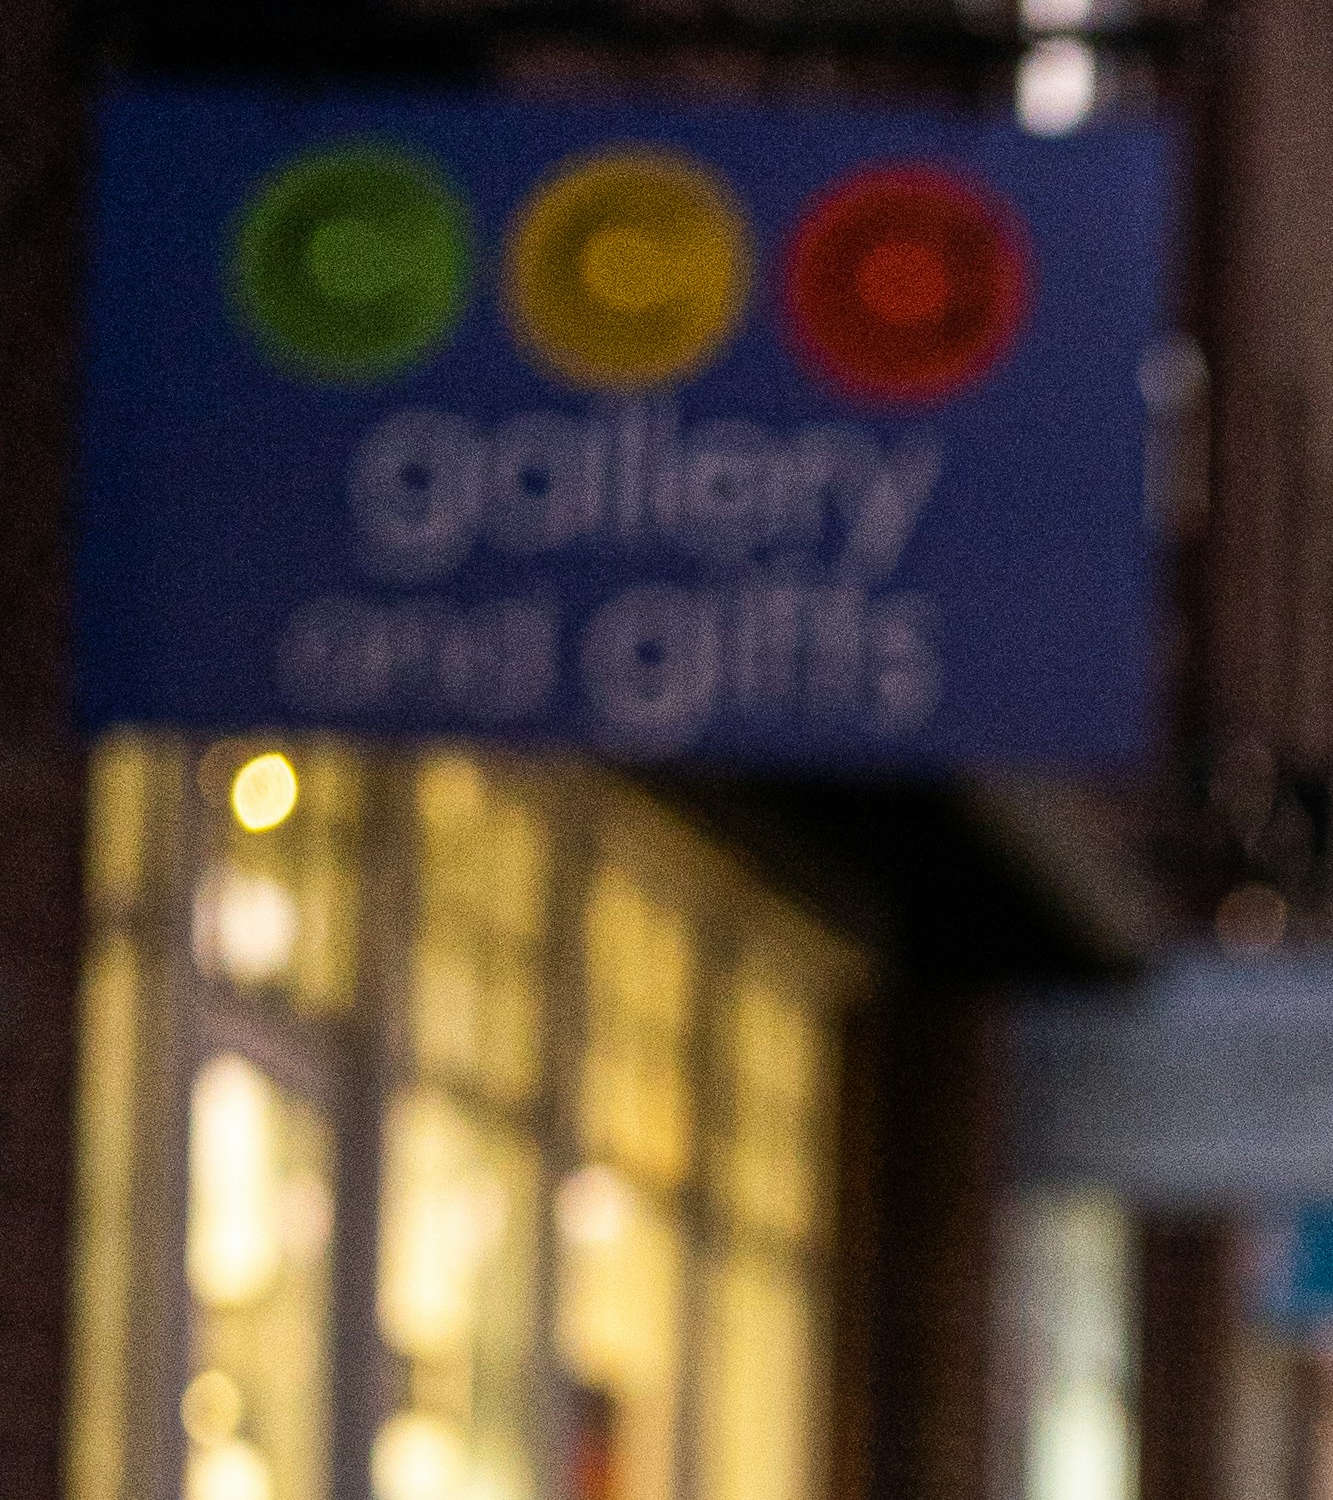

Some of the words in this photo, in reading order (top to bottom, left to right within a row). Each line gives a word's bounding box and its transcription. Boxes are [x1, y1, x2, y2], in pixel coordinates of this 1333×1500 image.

[354, 396, 942, 580] gallery
[281, 585, 558, 718] and
[586, 570, 938, 752] gifts
